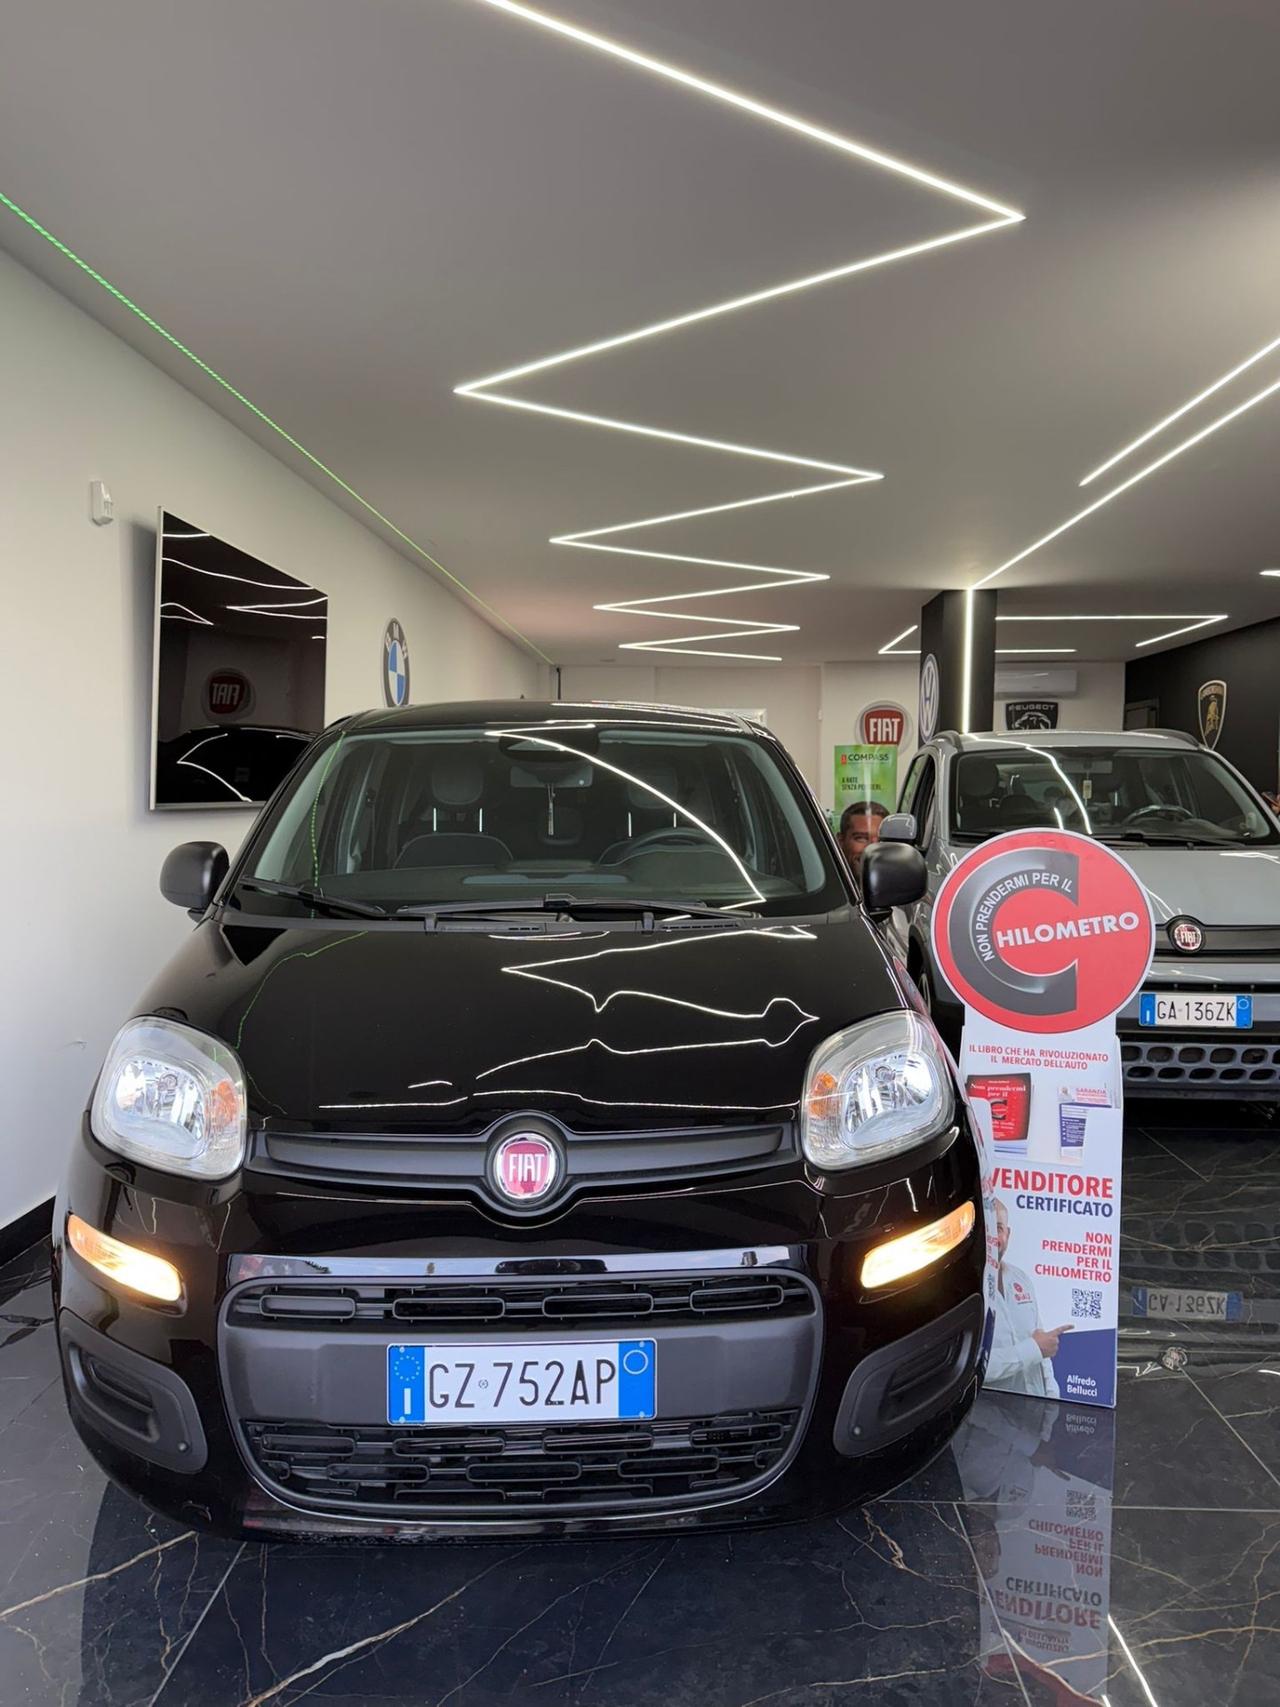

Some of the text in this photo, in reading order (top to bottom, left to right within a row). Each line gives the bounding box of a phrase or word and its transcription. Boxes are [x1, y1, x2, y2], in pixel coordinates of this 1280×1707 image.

[1008, 703, 1055, 711] PEUGEOT
[869, 718, 900, 742] FIAT
[848, 753, 889, 761] COMPASS
[976, 873, 1072, 962] NON PRENDERMI PER IL
[996, 911, 1139, 948] HILOMETRO
[969, 1044, 1109, 1062] IL LIBRO CHE HA RIVOLUZIONATO
[990, 1055, 1088, 1070] IL MERCATO DELL'AUTO
[509, 1153, 545, 1182] FIAT
[1016, 1194, 1113, 1218] CERTIFICATO
[1085, 1231, 1112, 1244] NON
[1042, 1240, 1112, 1258] PRENDERMI
[1077, 1256, 1112, 1271] PER IL
[1035, 1263, 1112, 1283] CHILOMETRO
[1066, 1374, 1096, 1387] Alfredo
[1066, 1384, 1098, 1397] Bellucci
